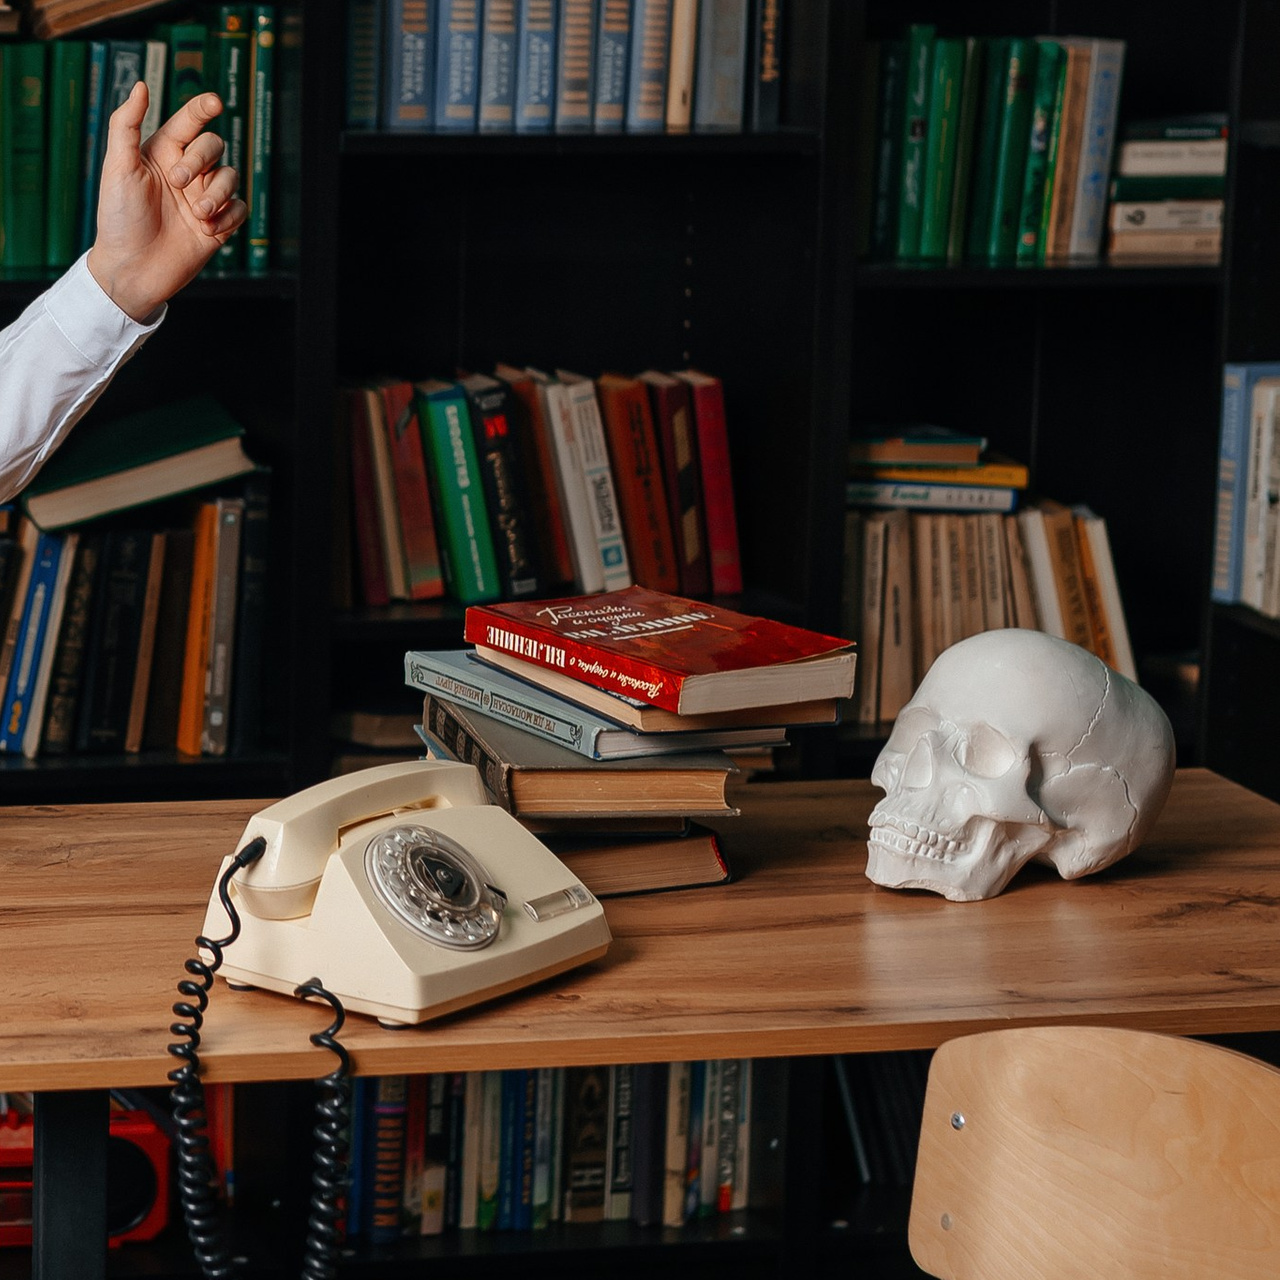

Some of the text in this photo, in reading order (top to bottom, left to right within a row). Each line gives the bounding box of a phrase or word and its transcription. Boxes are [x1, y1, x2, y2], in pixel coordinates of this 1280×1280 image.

[536, 604, 631, 626] Рассказы
[587, 610, 645, 624] очерки
[569, 657, 575, 666] о
[577, 657, 609, 680] очерки
[609, 669, 616, 679] и
[616, 670, 663, 699] Рассказы
[434, 675, 481, 700] МИЛЫЙ ДРУГ
[491, 699, 557, 732] ГИ ДЕ МОПАССАН
